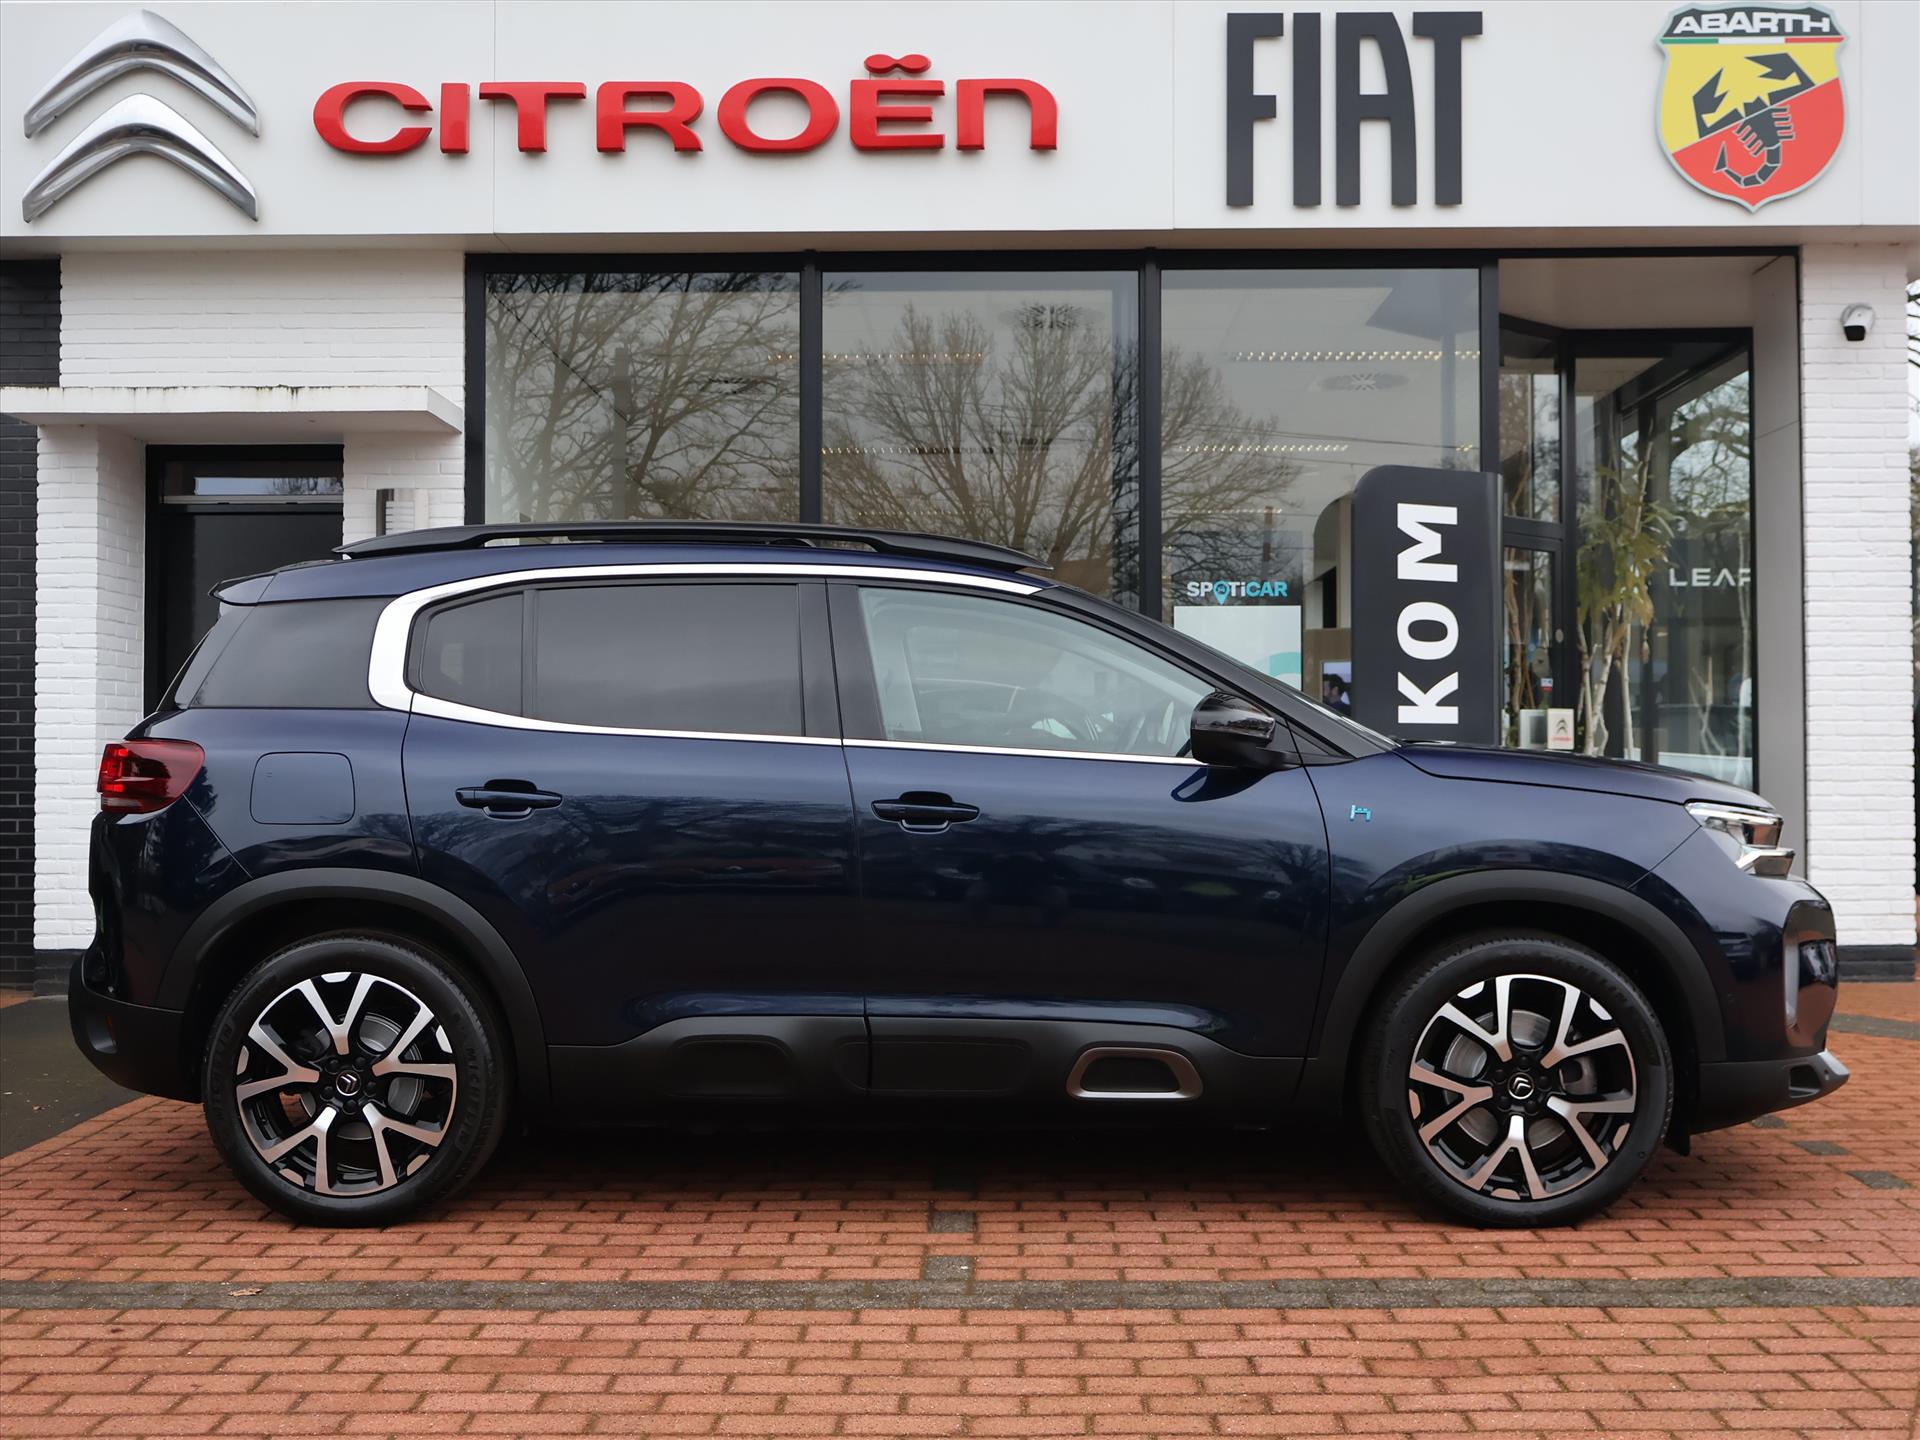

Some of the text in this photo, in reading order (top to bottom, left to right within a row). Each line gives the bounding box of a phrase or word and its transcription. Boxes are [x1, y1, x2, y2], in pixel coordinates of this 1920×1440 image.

[1672, 11, 1831, 34] ABARTH
[314, 53, 1058, 154] CITROËN
[1226, 11, 1482, 207] FIAT
[1397, 503, 1459, 725] KOM
